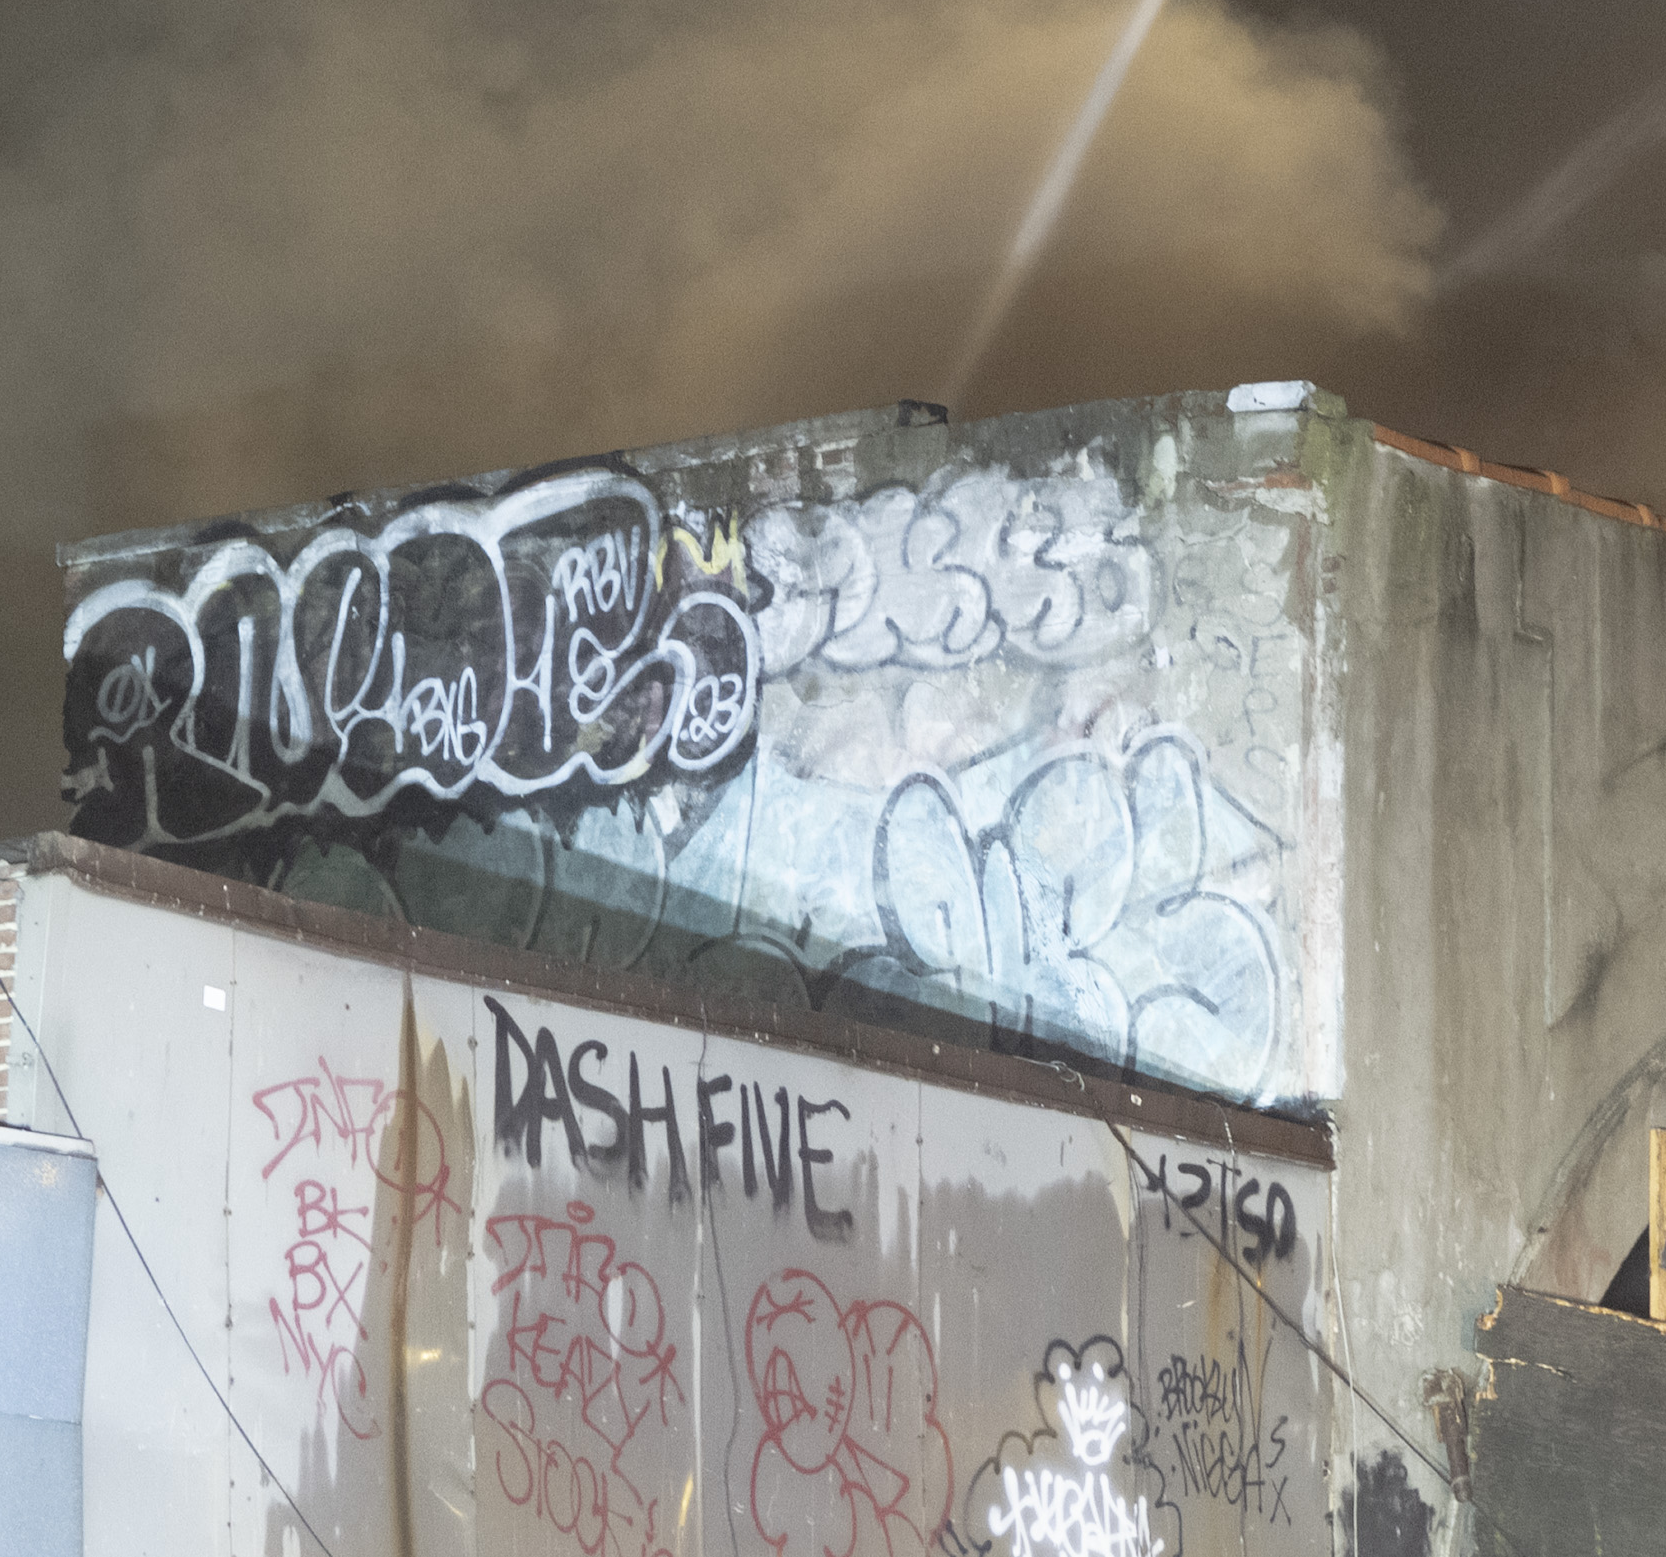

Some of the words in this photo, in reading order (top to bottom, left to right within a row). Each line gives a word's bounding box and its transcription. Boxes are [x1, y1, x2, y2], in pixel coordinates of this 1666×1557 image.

[483, 995, 692, 1208] DASH
[696, 1074, 854, 1242] FIVE
[284, 1240, 369, 1341] BX
[269, 1296, 383, 1440] NYC
